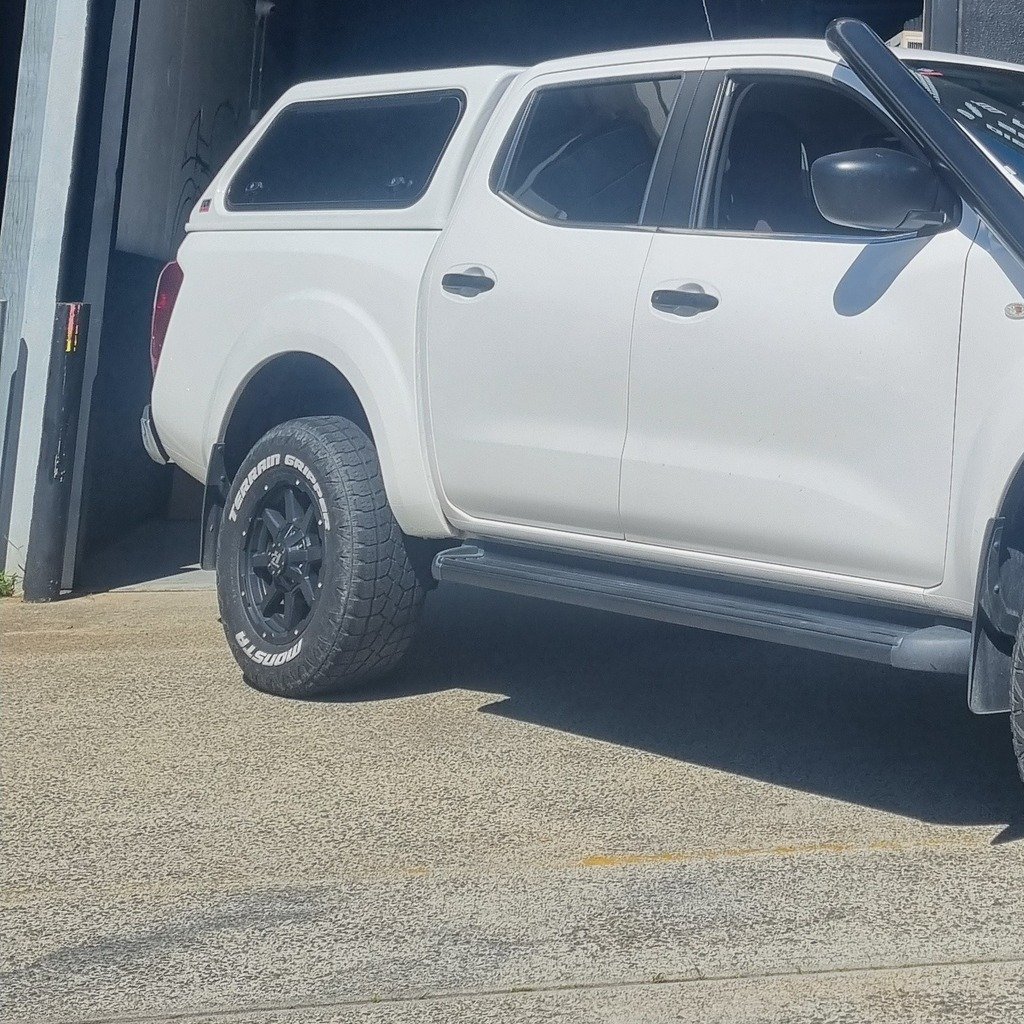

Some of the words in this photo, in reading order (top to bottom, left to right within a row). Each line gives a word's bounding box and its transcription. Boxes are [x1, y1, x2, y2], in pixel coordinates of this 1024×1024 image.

[228, 453, 281, 522] TERRAIN
[284, 455, 331, 531] GRIPPER
[235, 631, 303, 667] MONSTA
